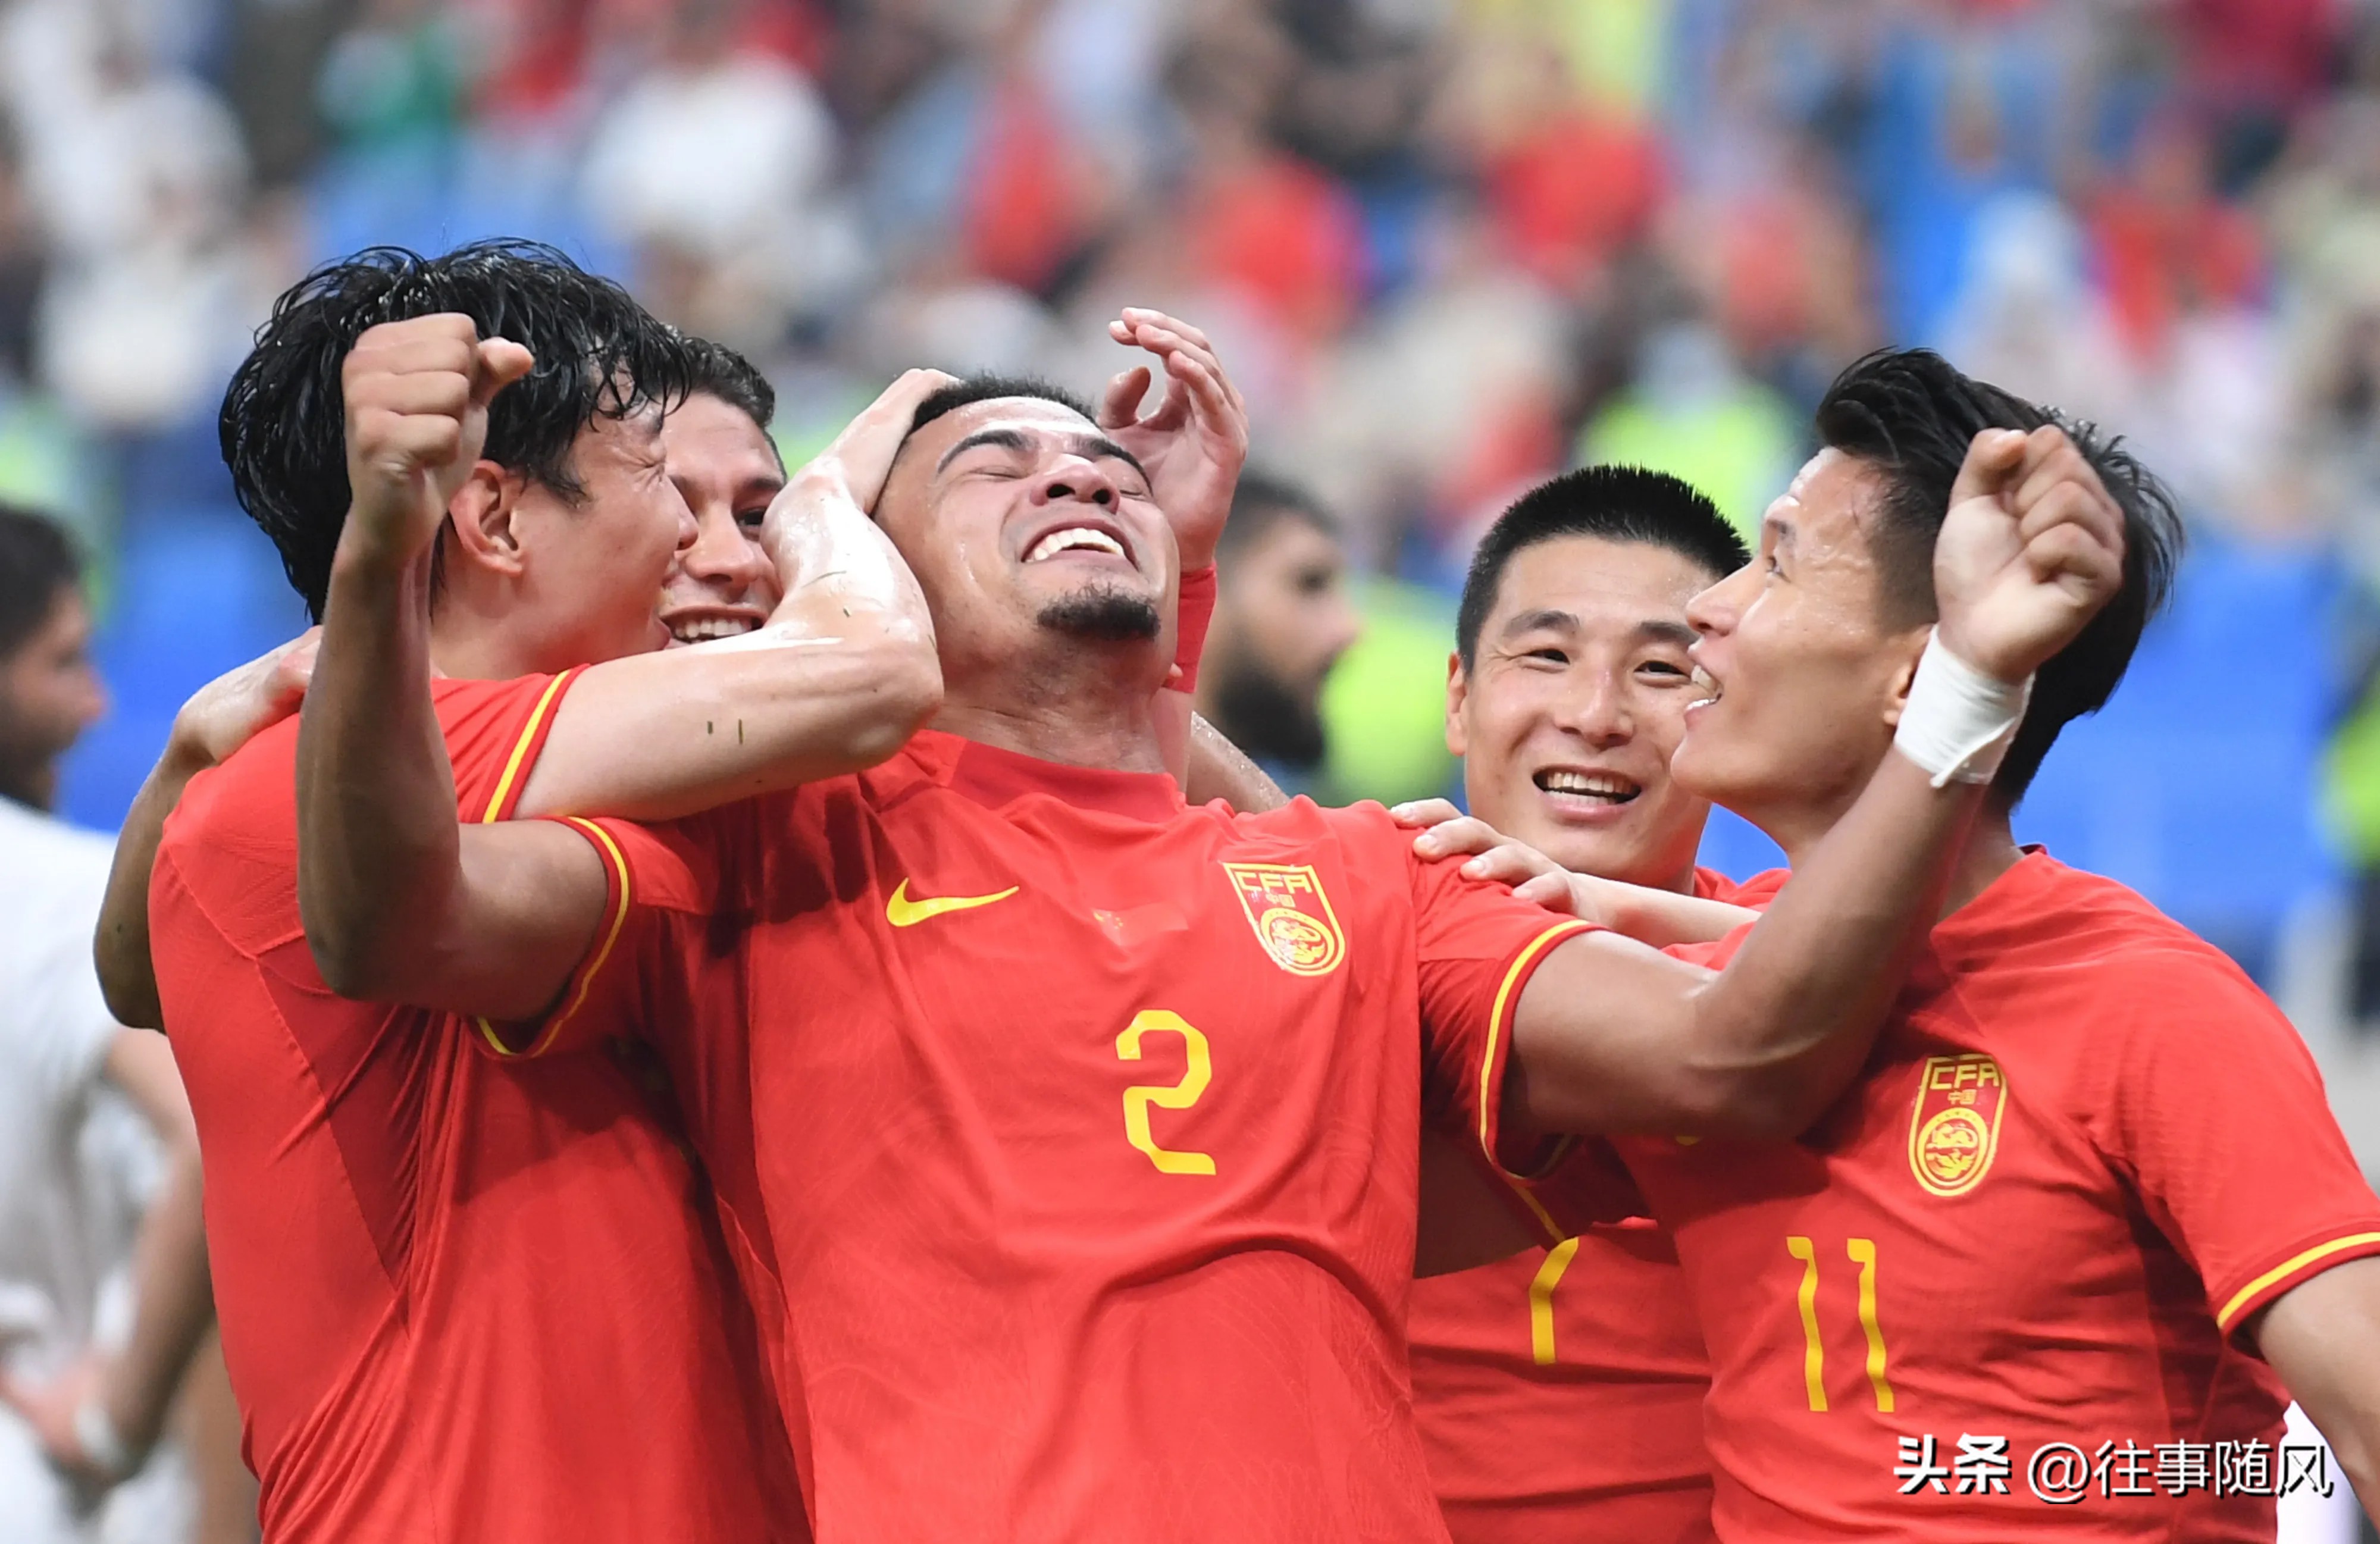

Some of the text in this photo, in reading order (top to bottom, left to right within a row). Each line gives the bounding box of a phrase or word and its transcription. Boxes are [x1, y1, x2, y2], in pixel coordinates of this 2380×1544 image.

[1234, 871, 1313, 894] CFA
[1116, 1010, 1216, 1175] 2
[1930, 1063, 1999, 1089] CFA
[1787, 1236, 1894, 1413] 11
